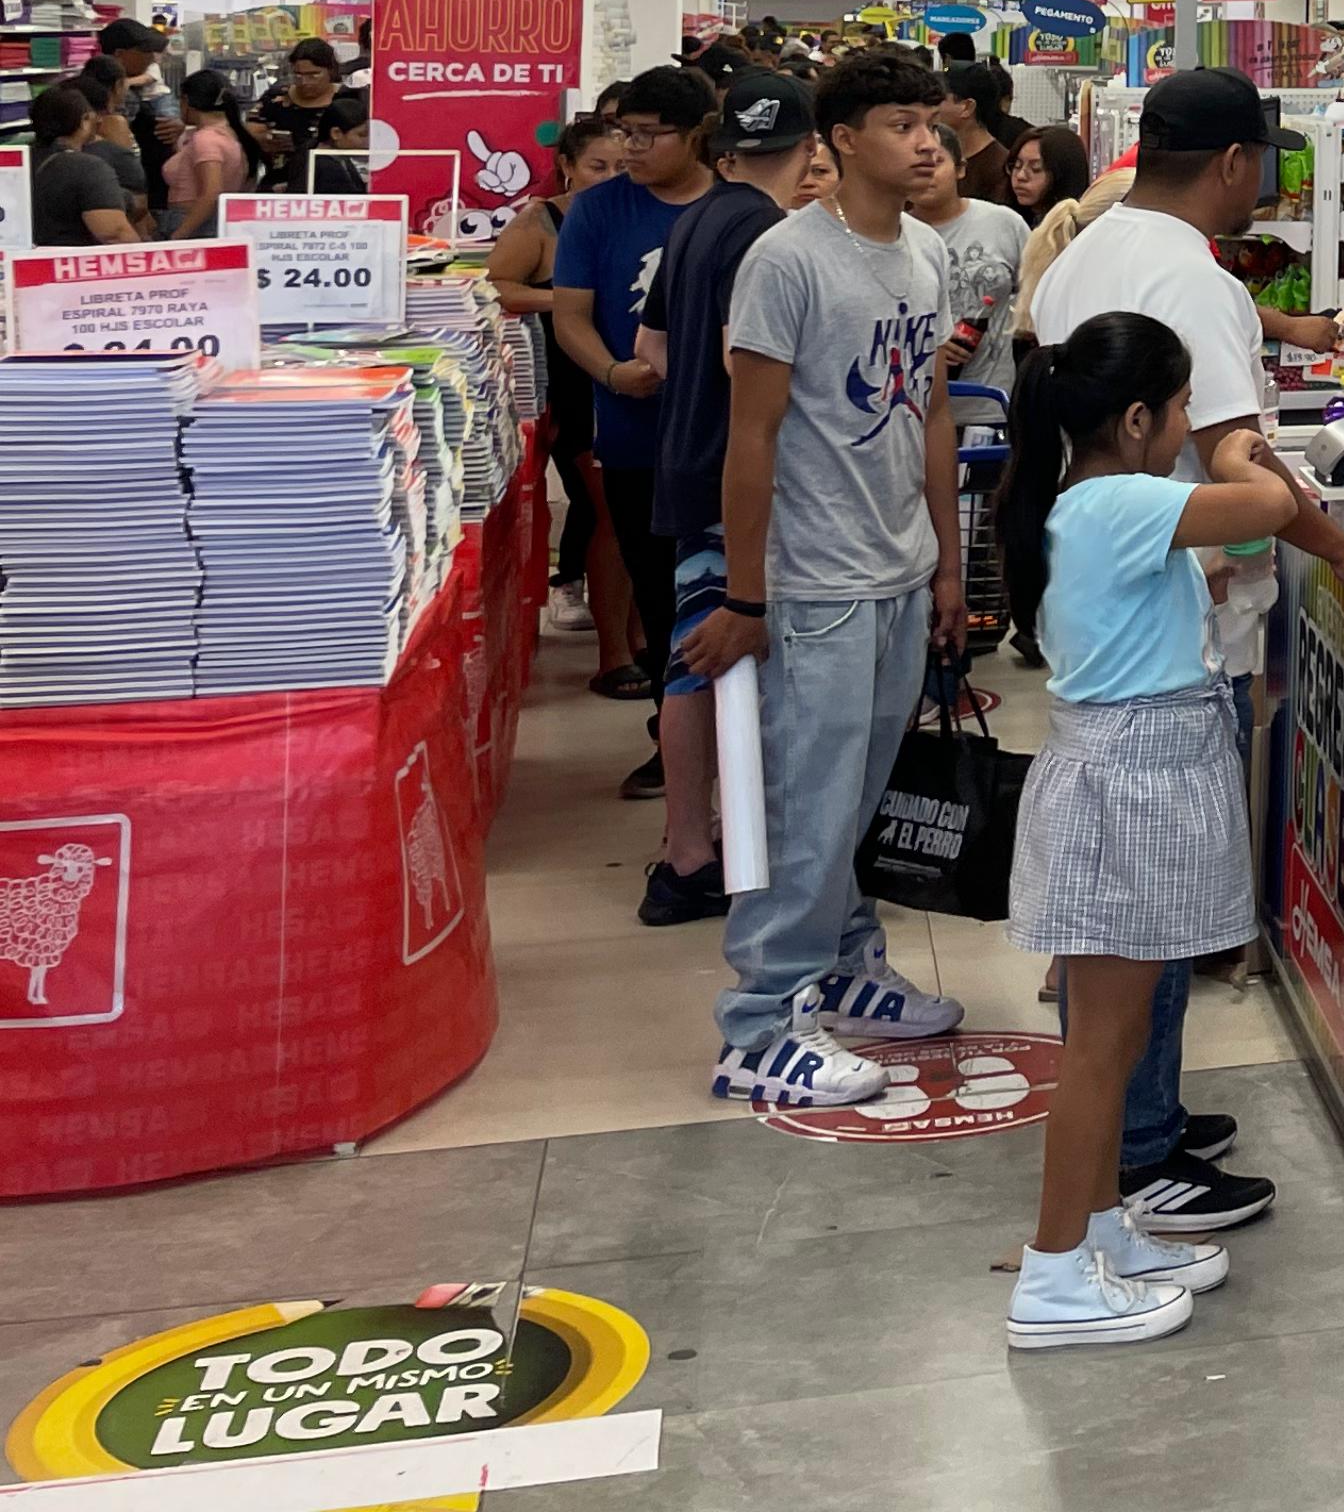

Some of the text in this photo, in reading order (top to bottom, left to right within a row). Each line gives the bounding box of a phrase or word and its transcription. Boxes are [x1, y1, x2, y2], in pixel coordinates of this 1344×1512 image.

[1034, 5, 1095, 25] PEGAMENTO
[388, 62, 564, 84] CERCA DE TI
[256, 200, 344, 218] HEMSA
[269, 230, 317, 239] LIBRETA
[53, 250, 173, 282] HEMSA
[296, 253, 350, 262] ESCOLAR
[284, 267, 372, 288] 24.00
[80, 288, 189, 306] LIBRETA PROF
[62, 308, 126, 320] ESPIRAL
[167, 301, 209, 313] RAYA
[71, 324, 96, 335] 100
[133, 316, 204, 330] ESCOLAR
[880, 790, 970, 831] CUIDADO CON
[898, 821, 963, 860] EL PERRO
[1291, 879, 1342, 1009] HEMSA
[912, 1109, 1014, 1129] HEMSA
[194, 1328, 504, 1392] TODO
[179, 1362, 494, 1412] EN UN MISMO
[150, 1383, 501, 1456] LUGAR
